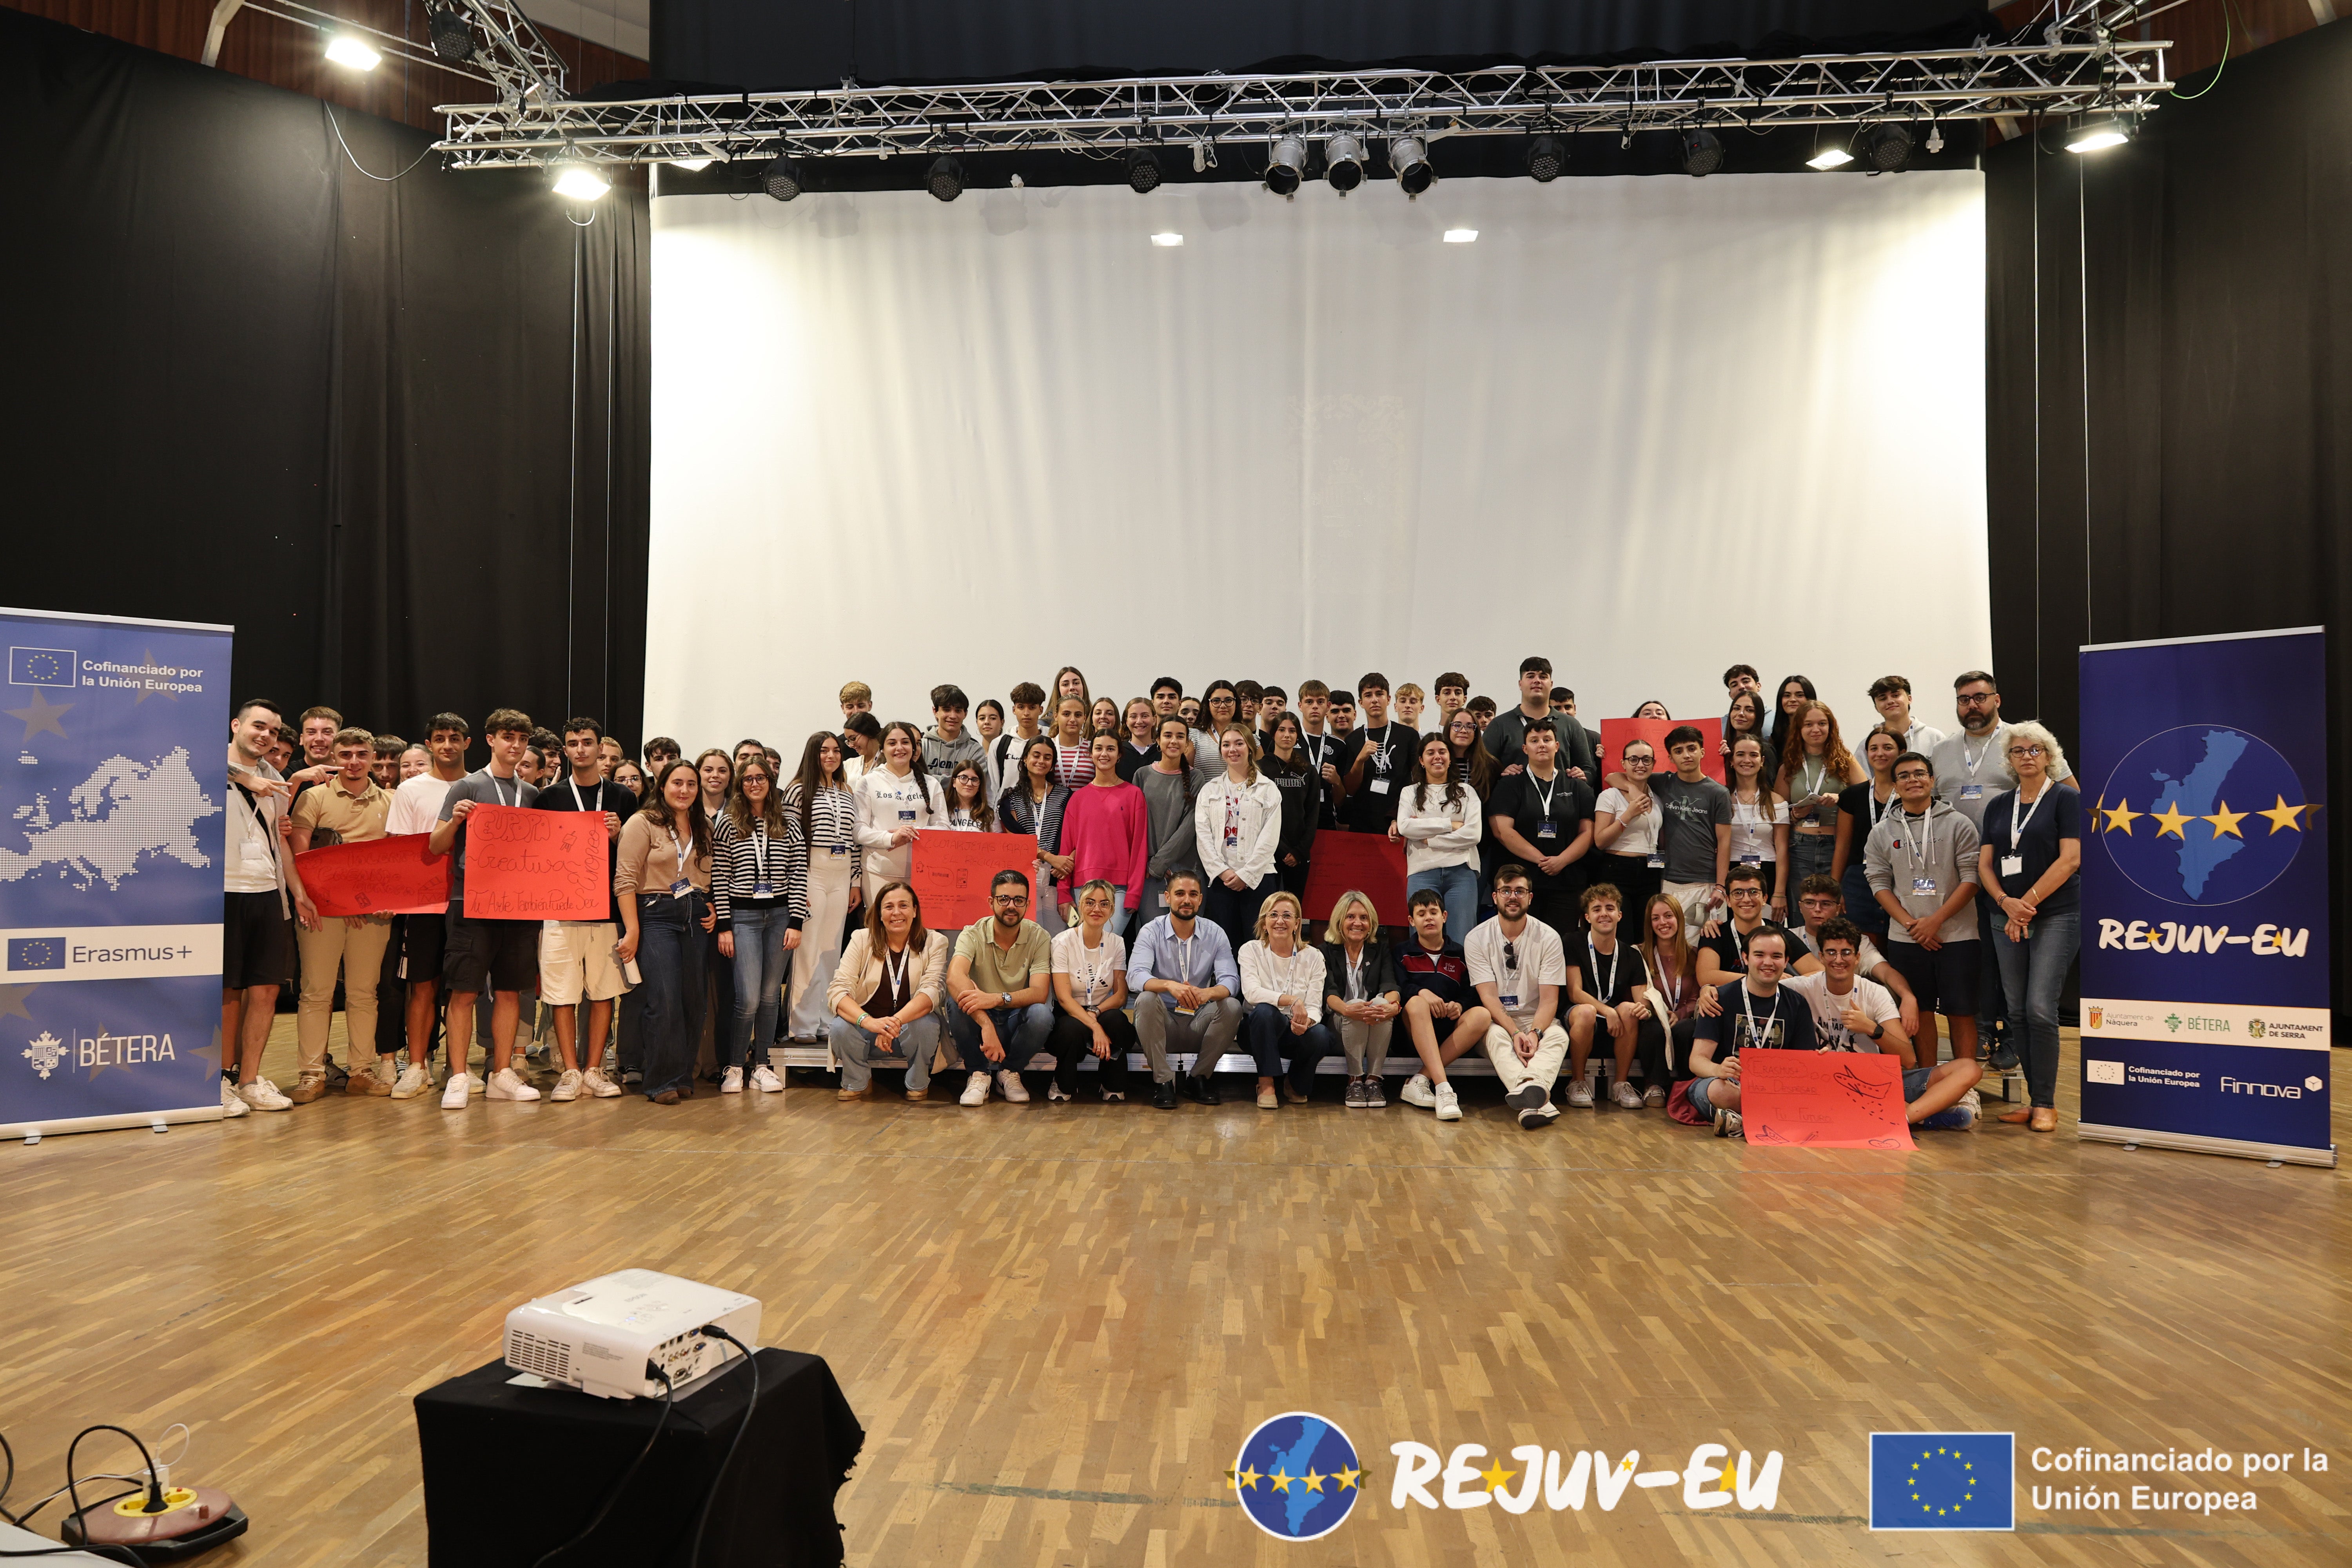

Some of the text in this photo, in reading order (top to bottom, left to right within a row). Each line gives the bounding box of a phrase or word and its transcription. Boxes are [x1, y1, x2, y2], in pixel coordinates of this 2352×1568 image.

[82, 660, 203, 679] Cofinanciado por
[82, 675, 202, 693] la Unión Europea
[1274, 778, 1301, 787] PUMA
[875, 791, 924, 801] Los Agele
[950, 818, 982, 829] ANGELE
[487, 891, 514, 914] Arte
[575, 888, 599, 911] Ser
[2098, 918, 2309, 957] REJUV-EU
[73, 945, 192, 963] Erasmus+
[2188, 1016, 2230, 1032] BÉTERA
[2269, 1023, 2323, 1032] AJUNTAMENT
[80, 1033, 176, 1067] BÉTERA
[2128, 1066, 2183, 1078] Cofinanciado
[2138, 1076, 2163, 1084] Unión
[2164, 1078, 2200, 1089] Europea
[2220, 1076, 2301, 1099] Finnova
